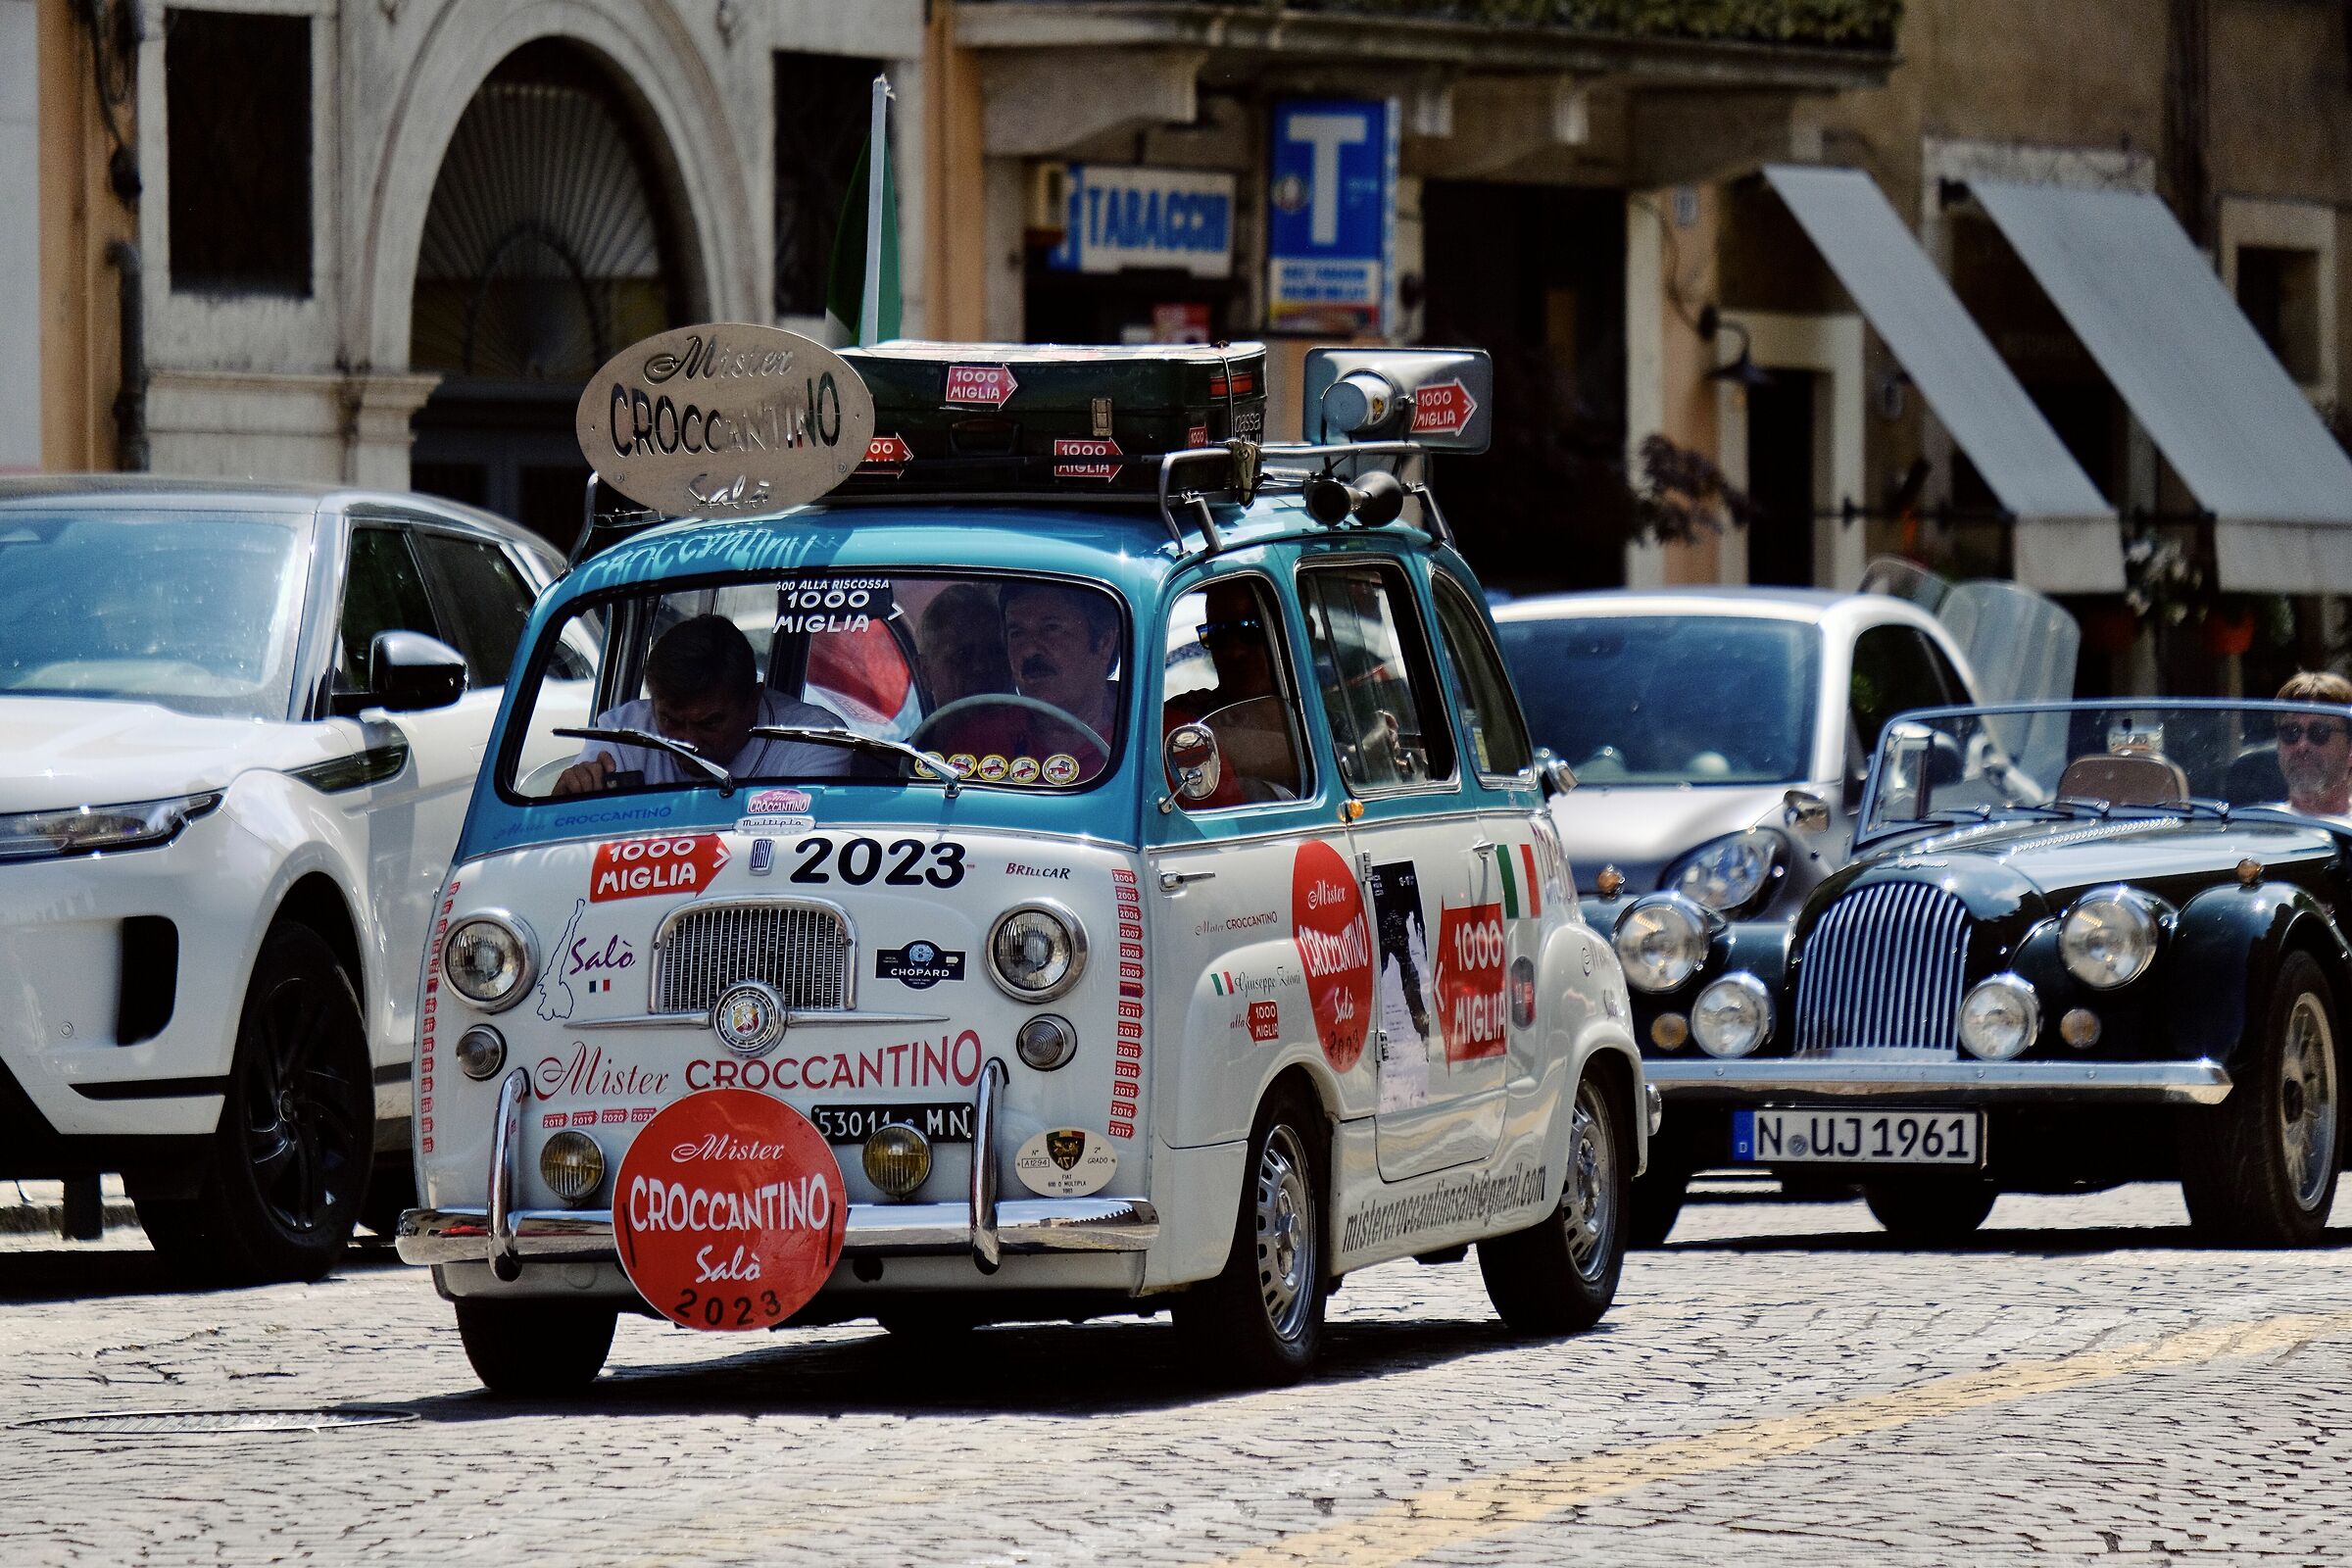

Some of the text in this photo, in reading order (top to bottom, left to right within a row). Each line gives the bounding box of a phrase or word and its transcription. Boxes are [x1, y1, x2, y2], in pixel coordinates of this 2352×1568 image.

[1287, 112, 1368, 247] T
[643, 335, 794, 386] Mister
[955, 371, 1000, 383] 1000
[950, 386, 1001, 400] MIGLIA
[1420, 391, 1452, 408] 1000
[610, 370, 842, 459] CROCCANTINO
[1415, 411, 1456, 427] MIGLIA
[1061, 445, 1106, 456] 1000
[775, 579, 890, 591] 600 ALLA RISCOSSA
[787, 590, 870, 609] 1000
[772, 614, 869, 634] MIGLIA
[750, 799, 808, 812] CROCCANTINO
[554, 807, 672, 828] CROCCANTINO
[610, 839, 696, 862] 1000
[752, 839, 773, 869] FIAT
[789, 837, 966, 889] 2023
[597, 862, 697, 895] MIGLIA
[1307, 879, 1347, 910] Mister
[1119, 909, 1139, 919] 2006
[1226, 910, 1278, 930] CROCCANTINO
[1120, 929, 1139, 938] 2007
[1121, 949, 1140, 957] 2008
[1298, 911, 1369, 978] CROCCANTINO
[1454, 919, 1503, 972] 1000
[569, 934, 636, 976] Salò
[890, 968, 951, 977] CHOPARD
[1121, 967, 1141, 977] 2009
[1234, 971, 1276, 999] Giuseppe
[1119, 1007, 1140, 1017] 2011
[1255, 1005, 1276, 1019] 1000
[1334, 986, 1354, 1025] Salò
[1453, 992, 1507, 1045] MIGLIA
[1118, 1027, 1139, 1037] 2012
[1255, 1022, 1278, 1039] MIGLIA
[1117, 1047, 1138, 1057] 2013
[1329, 1029, 1360, 1066] 2023
[533, 1029, 982, 1101] Mister CROCCANTINO
[1116, 1066, 1137, 1077] 2014
[1114, 1086, 1135, 1097] 2015
[603, 1114, 625, 1123] 2020
[632, 1112, 652, 1122] 2021
[1111, 1106, 1132, 1117] 2016
[544, 1118, 564, 1128] 2018
[926, 1108, 968, 1137] MN
[1109, 1127, 1131, 1137] 2017
[1758, 1117, 1970, 1158] N UJ 1961
[671, 1133, 785, 1163] Mister
[629, 1172, 830, 1233] CROCCANTINO
[696, 1244, 761, 1284] Salò
[673, 1288, 782, 1326] 2023
